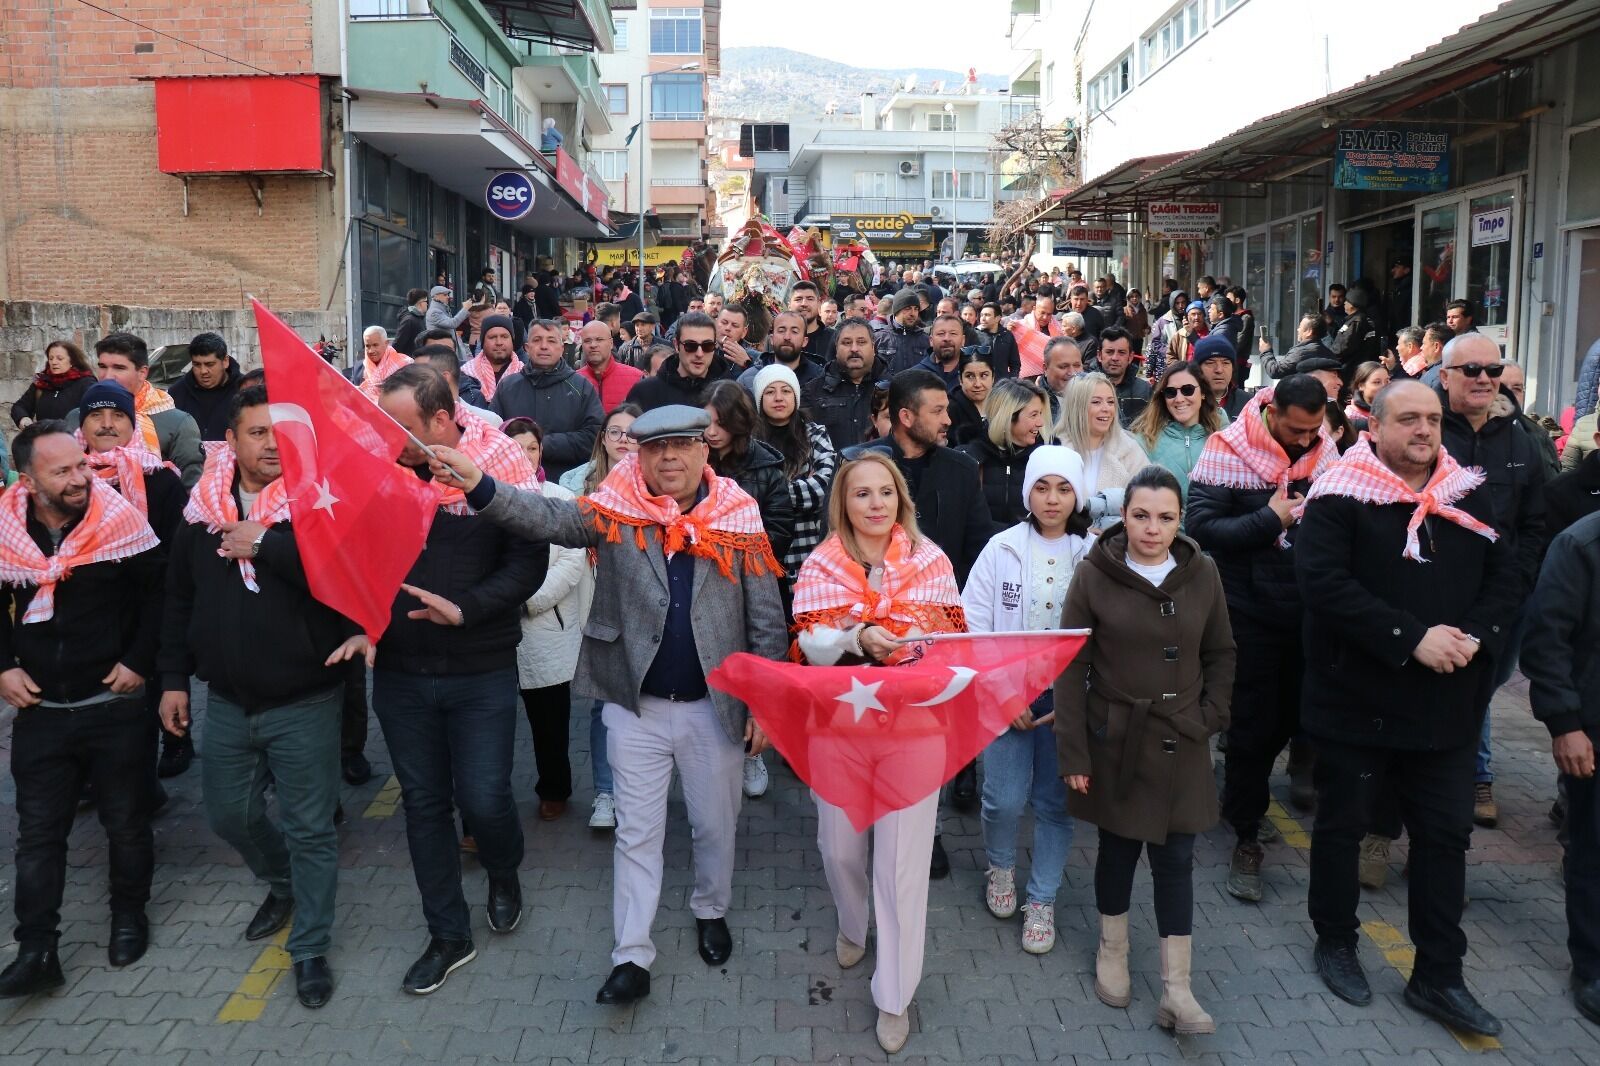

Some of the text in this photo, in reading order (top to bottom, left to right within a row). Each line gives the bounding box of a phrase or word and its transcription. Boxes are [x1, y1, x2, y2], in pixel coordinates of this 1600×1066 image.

[1407, 131, 1449, 143] Bobinaj
[1407, 141, 1447, 152] Elektrik
[491, 185, 528, 203] seç
[1150, 202, 1218, 215] ÇAĞIN TERZİSİ
[856, 217, 905, 230] cadde
[1478, 216, 1504, 233] impo
[1002, 582, 1022, 592] BLT
[1002, 591, 1021, 599] HIGH
